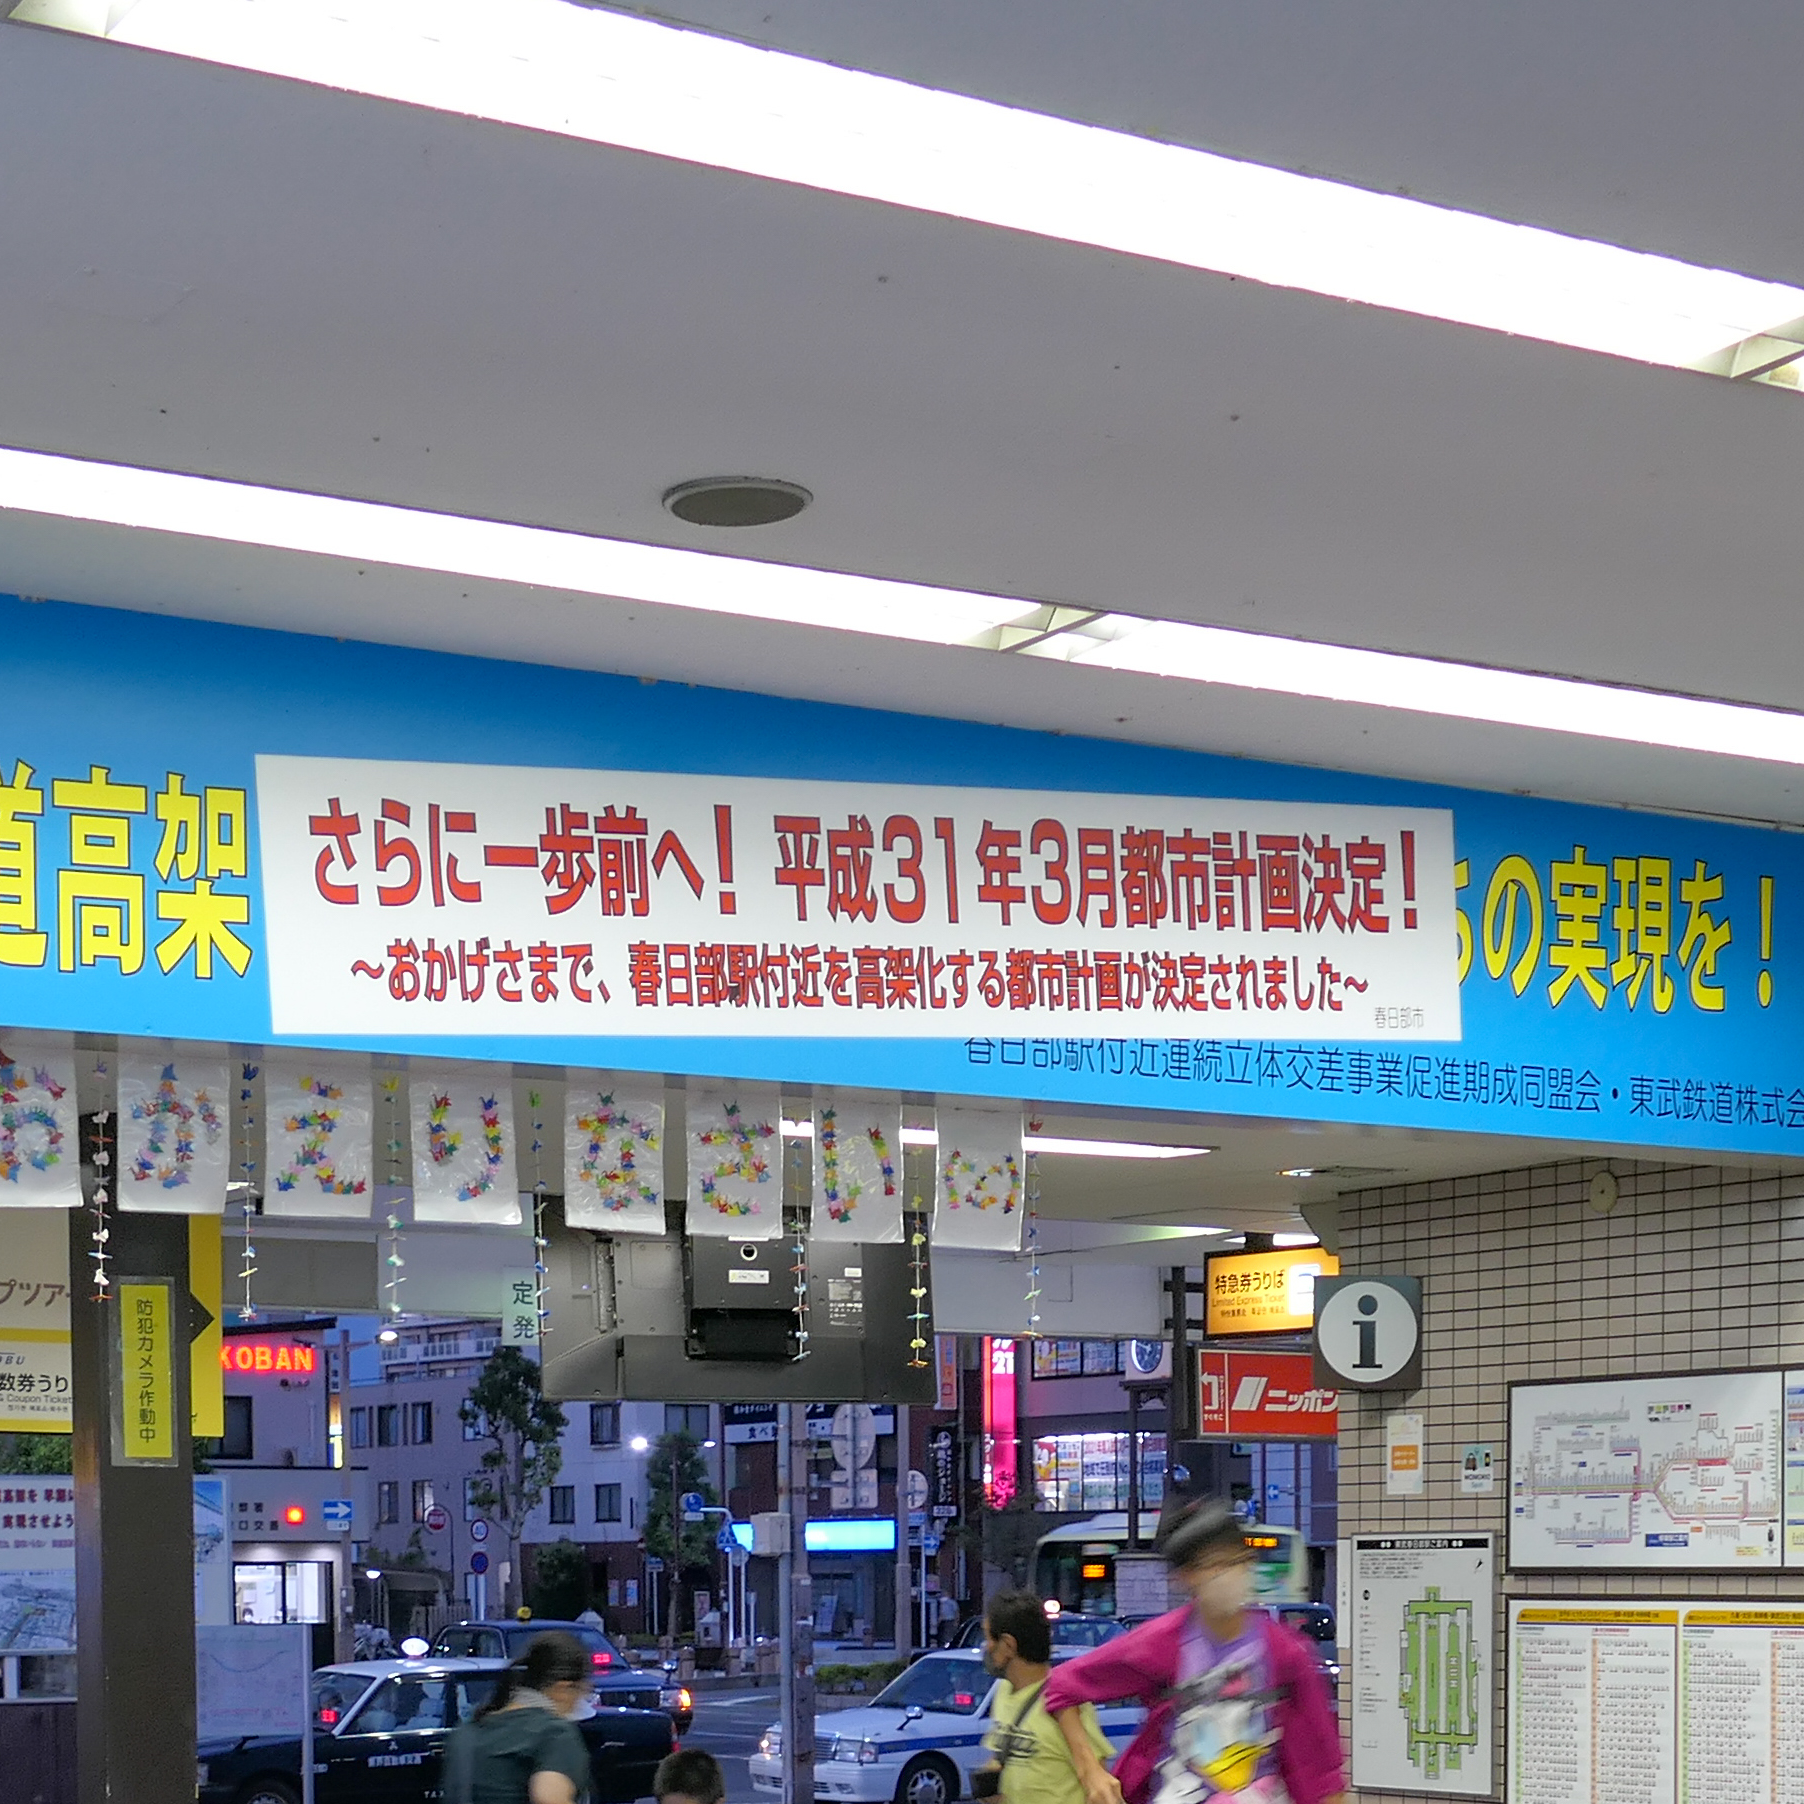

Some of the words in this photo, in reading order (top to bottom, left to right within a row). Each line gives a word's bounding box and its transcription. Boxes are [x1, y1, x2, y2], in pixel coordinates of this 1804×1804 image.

[307, 795, 739, 919] さらに一歩前へ！
[1374, 1006, 1426, 1031] 春日部市
[1214, 1269, 1286, 1296] 特急券うりば
[135, 1297, 157, 1444] 防犯カメラ作動中
[219, 1346, 315, 1372] KOBAN
[992, 1351, 1015, 1375] 21
[1264, 1388, 1339, 1413] ニッポン
[474, 1525, 486, 1537] 40
